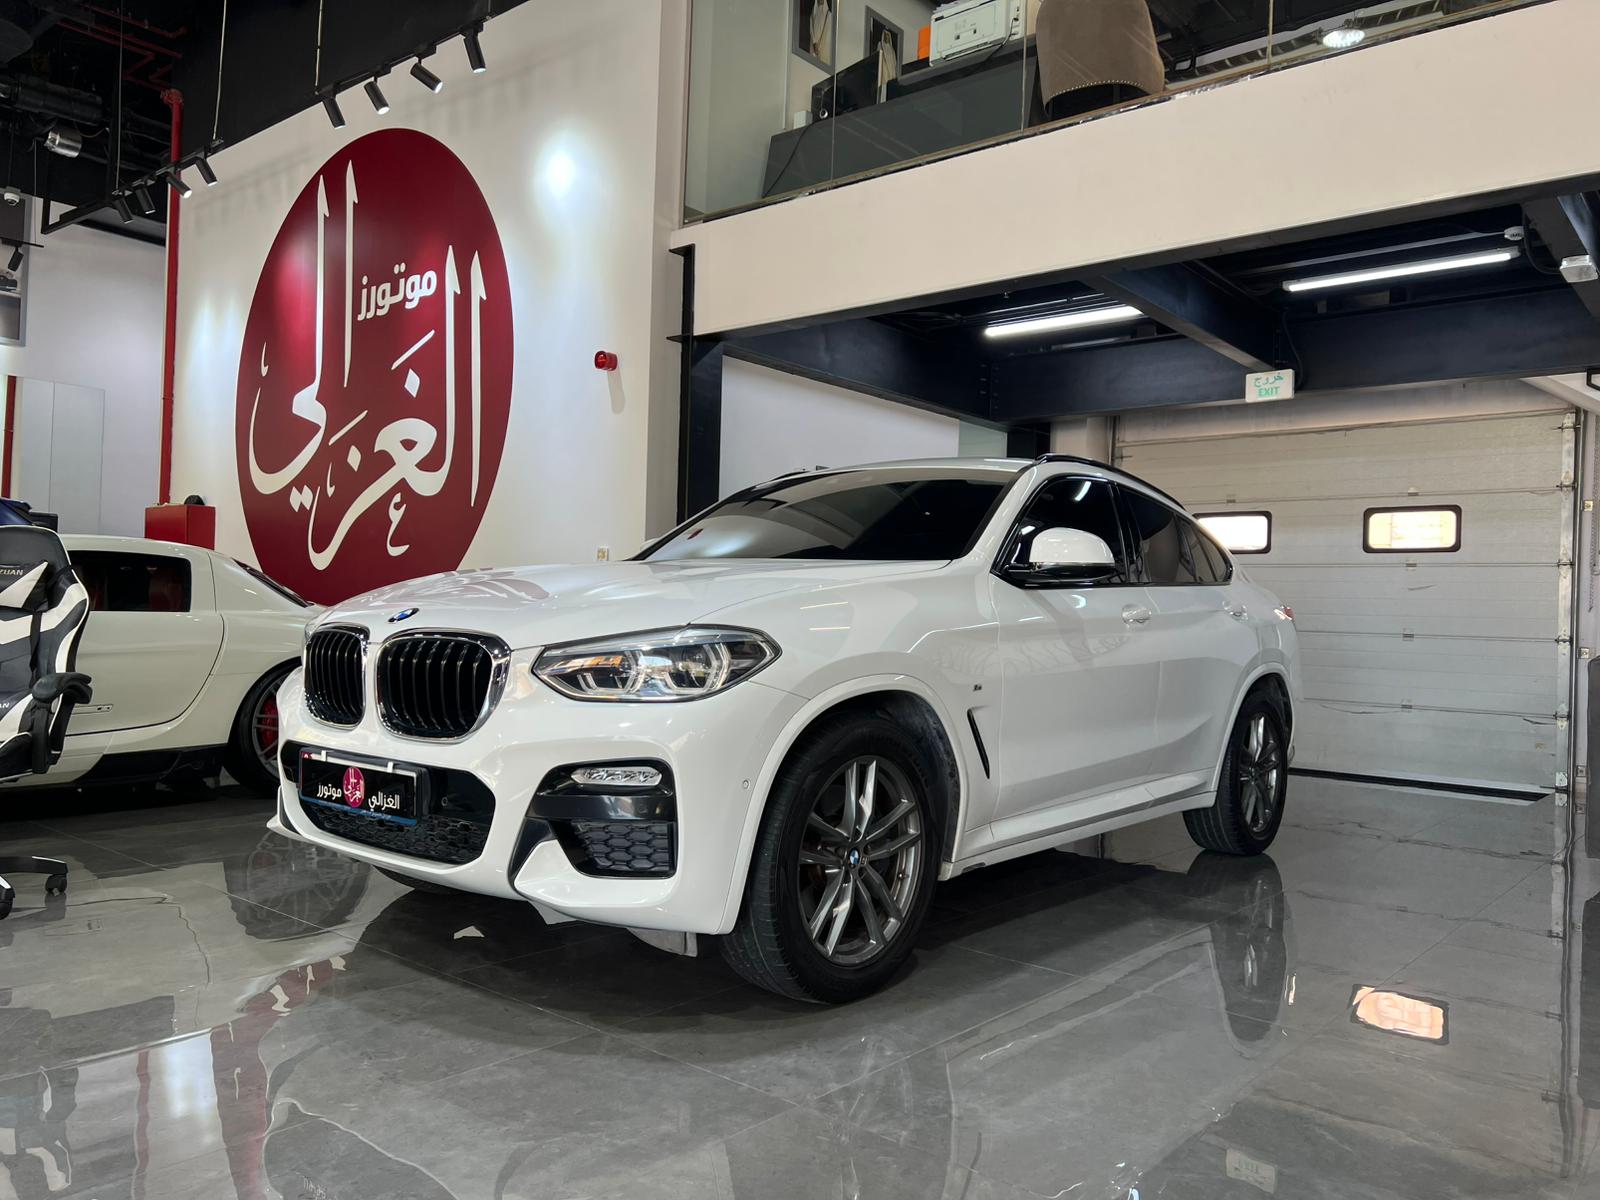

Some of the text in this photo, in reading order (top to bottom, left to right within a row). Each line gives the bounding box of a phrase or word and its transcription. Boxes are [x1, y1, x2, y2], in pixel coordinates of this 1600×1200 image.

[357, 262, 437, 320] موتورز
[1258, 387, 1280, 397] EXIT
[368, 791, 400, 812] الغزالي
